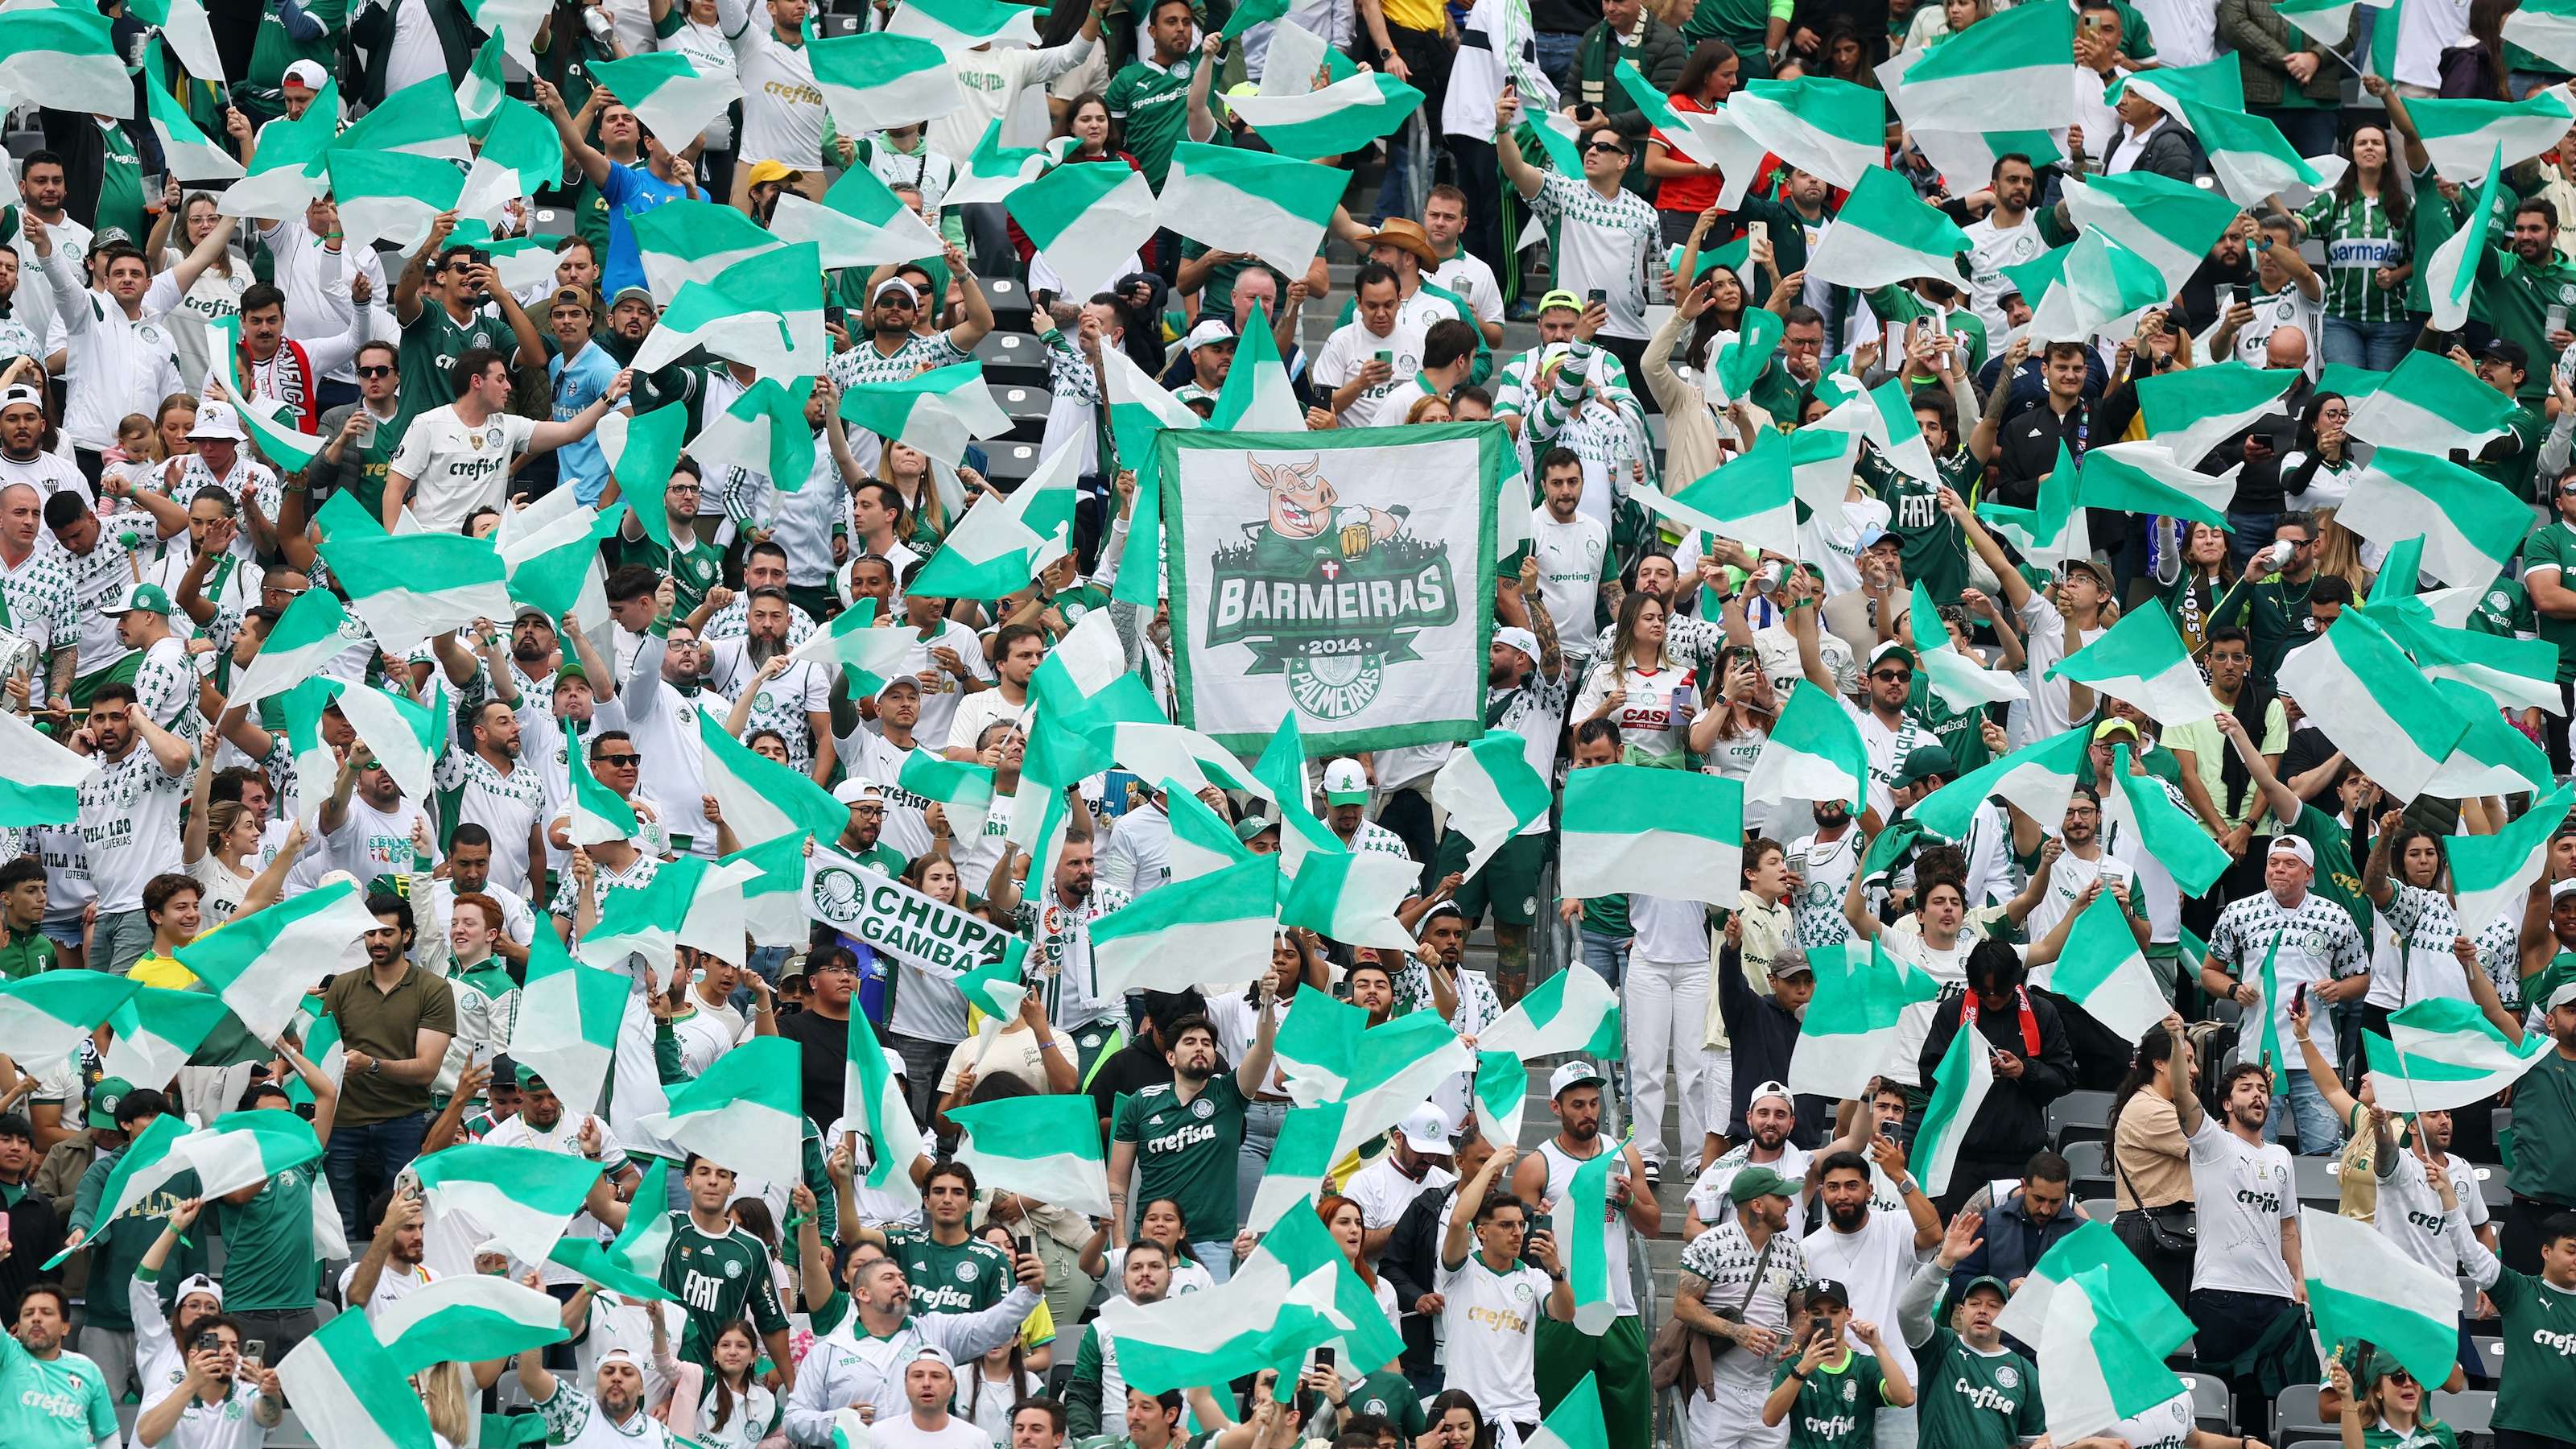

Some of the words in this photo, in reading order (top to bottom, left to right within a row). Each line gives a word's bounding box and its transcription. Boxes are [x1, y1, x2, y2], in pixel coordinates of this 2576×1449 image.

[764, 80, 823, 106] crefisa
[1897, 493, 1938, 529] FIAT
[1549, 571, 1600, 584] sporting
[1216, 564, 1446, 628] BARMEIRAS
[1309, 638, 1363, 655] 2014
[1290, 667, 1381, 718] PALMEIRAS
[871, 886, 1008, 964] CHUPA
[861, 916, 976, 972] GAMBÁ
[1147, 1123, 1217, 1154] crefisa
[683, 1267, 724, 1314] FIAT
[908, 1284, 973, 1311] crefisa
[1468, 1306, 1528, 1335] crefisa
[838, 1355, 863, 1368] 1983
[1955, 1377, 2016, 1415] crefisa
